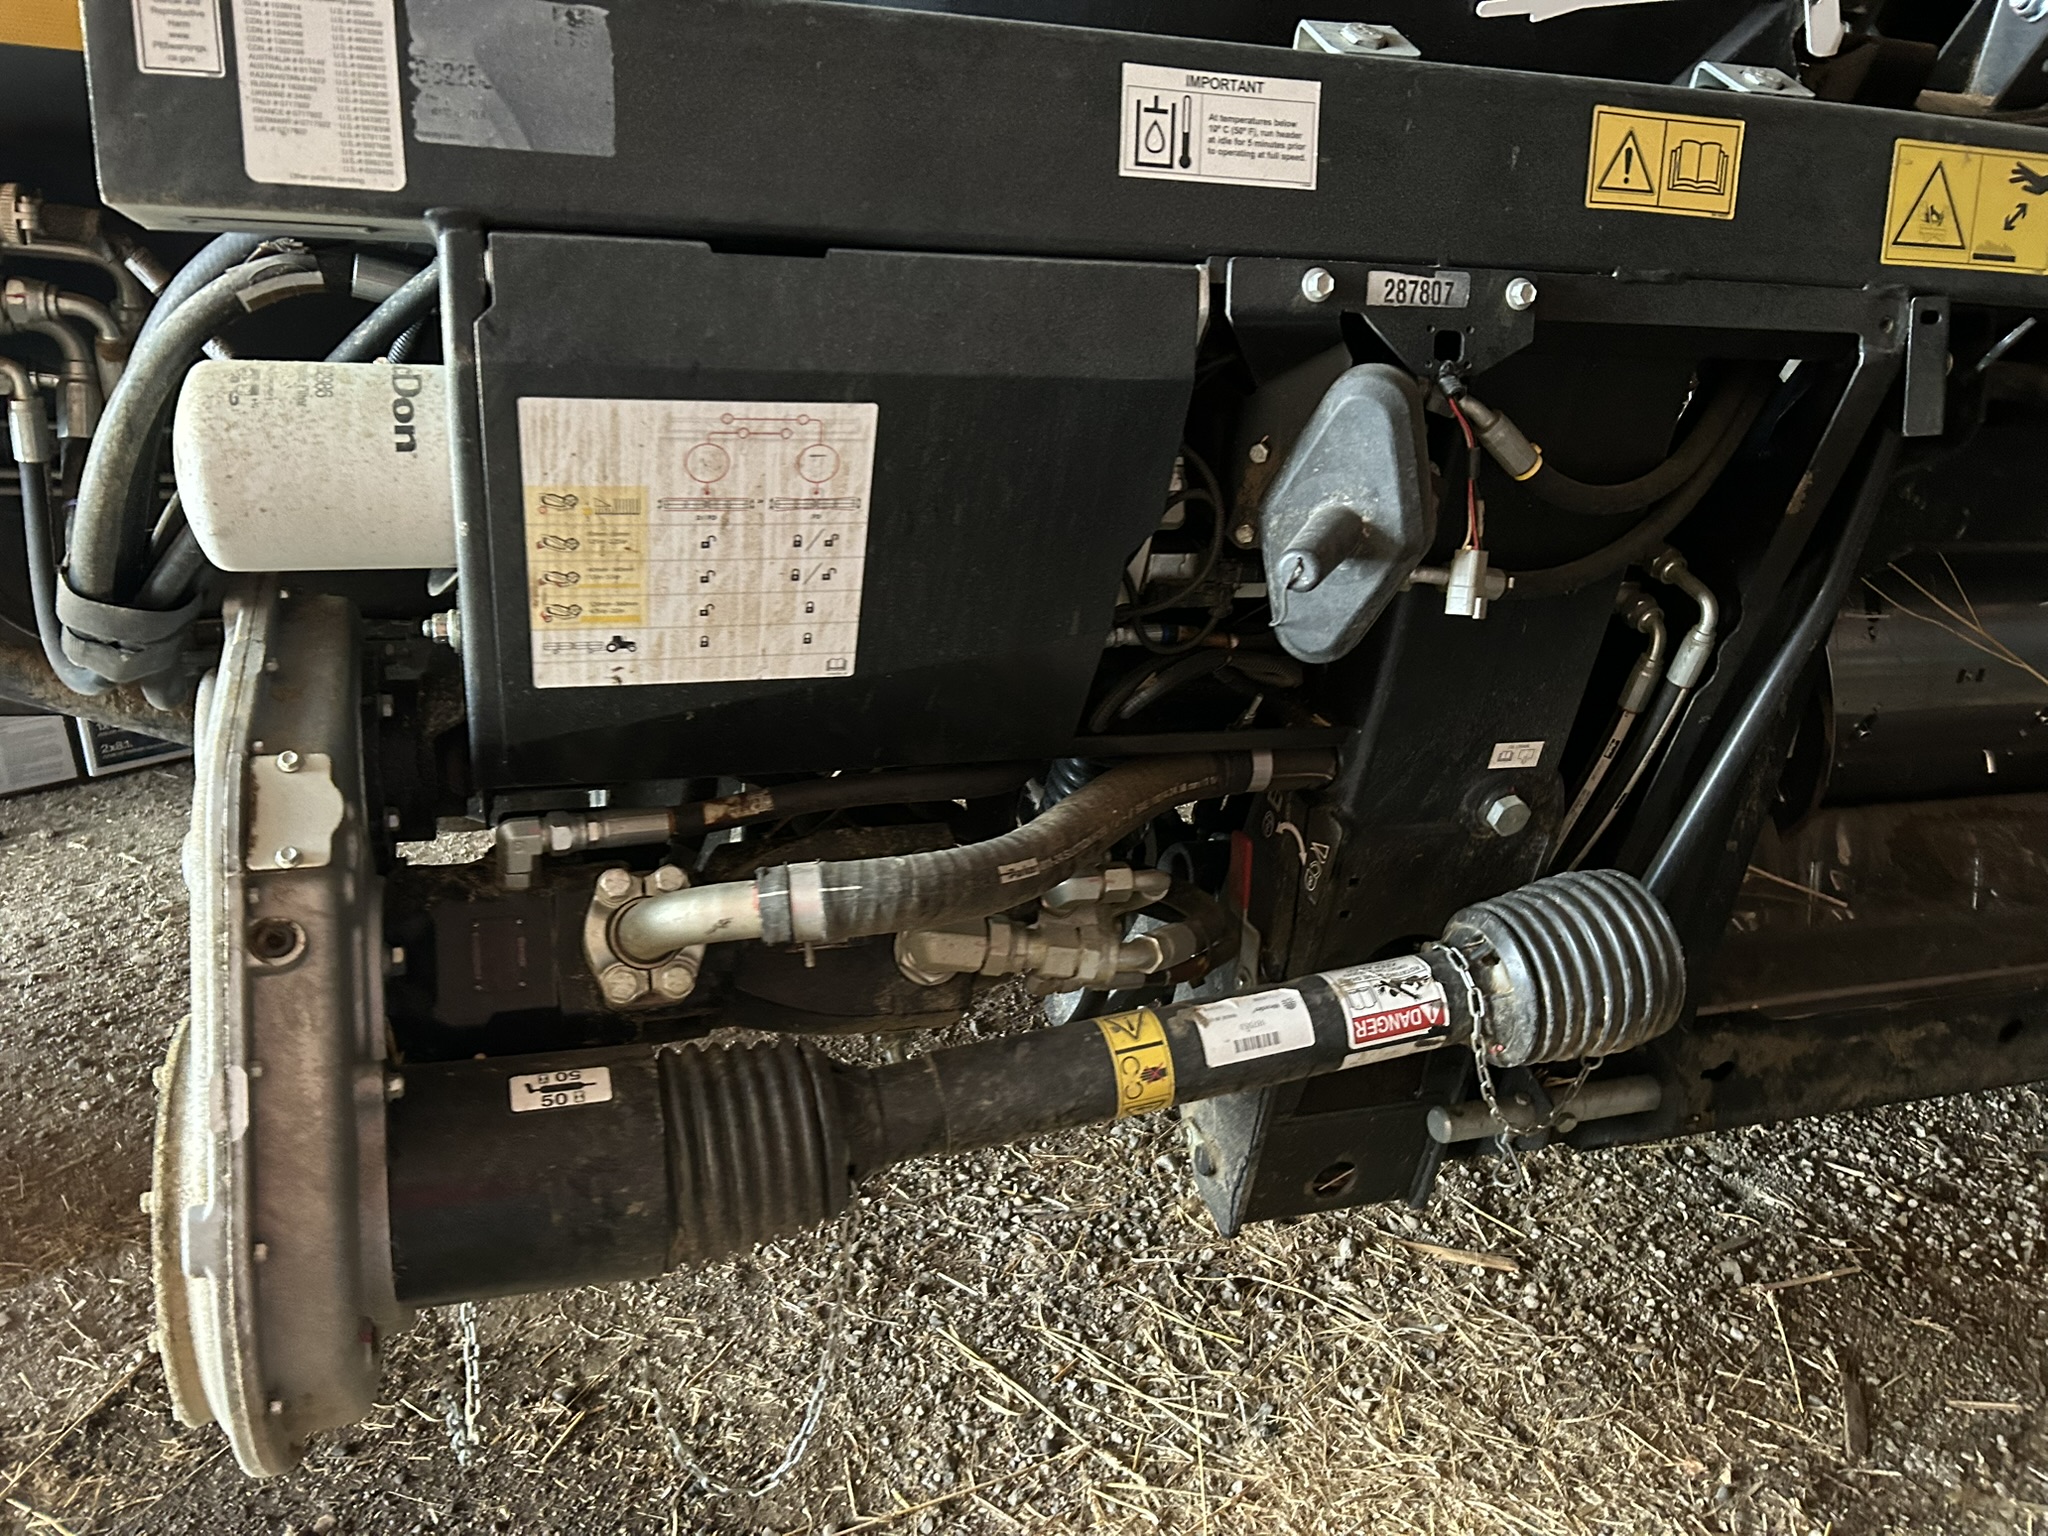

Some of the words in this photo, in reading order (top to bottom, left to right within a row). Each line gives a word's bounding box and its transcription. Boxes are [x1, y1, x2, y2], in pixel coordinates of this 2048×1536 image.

[1186, 75, 1265, 94] IMPORTANT
[1208, 113, 1218, 121] At
[1220, 114, 1272, 127] temperatures
[1274, 119, 1297, 128] below
[1276, 130, 1302, 139] header
[1218, 137, 1231, 145] idle
[1234, 138, 1246, 146] for
[1248, 139, 1253, 147] 5
[1254, 140, 1286, 150] minutes
[1287, 143, 1306, 152] prior
[1207, 147, 1216, 155] to
[1218, 148, 1255, 159] operating
[1267, 151, 1278, 159] full
[1280, 154, 1306, 163] speed.
[1384, 278, 1454, 305] 287807
[1354, 1008, 1422, 1039] DANGER
[555, 1070, 582, 1082] 50
[541, 1092, 568, 1107] 50
